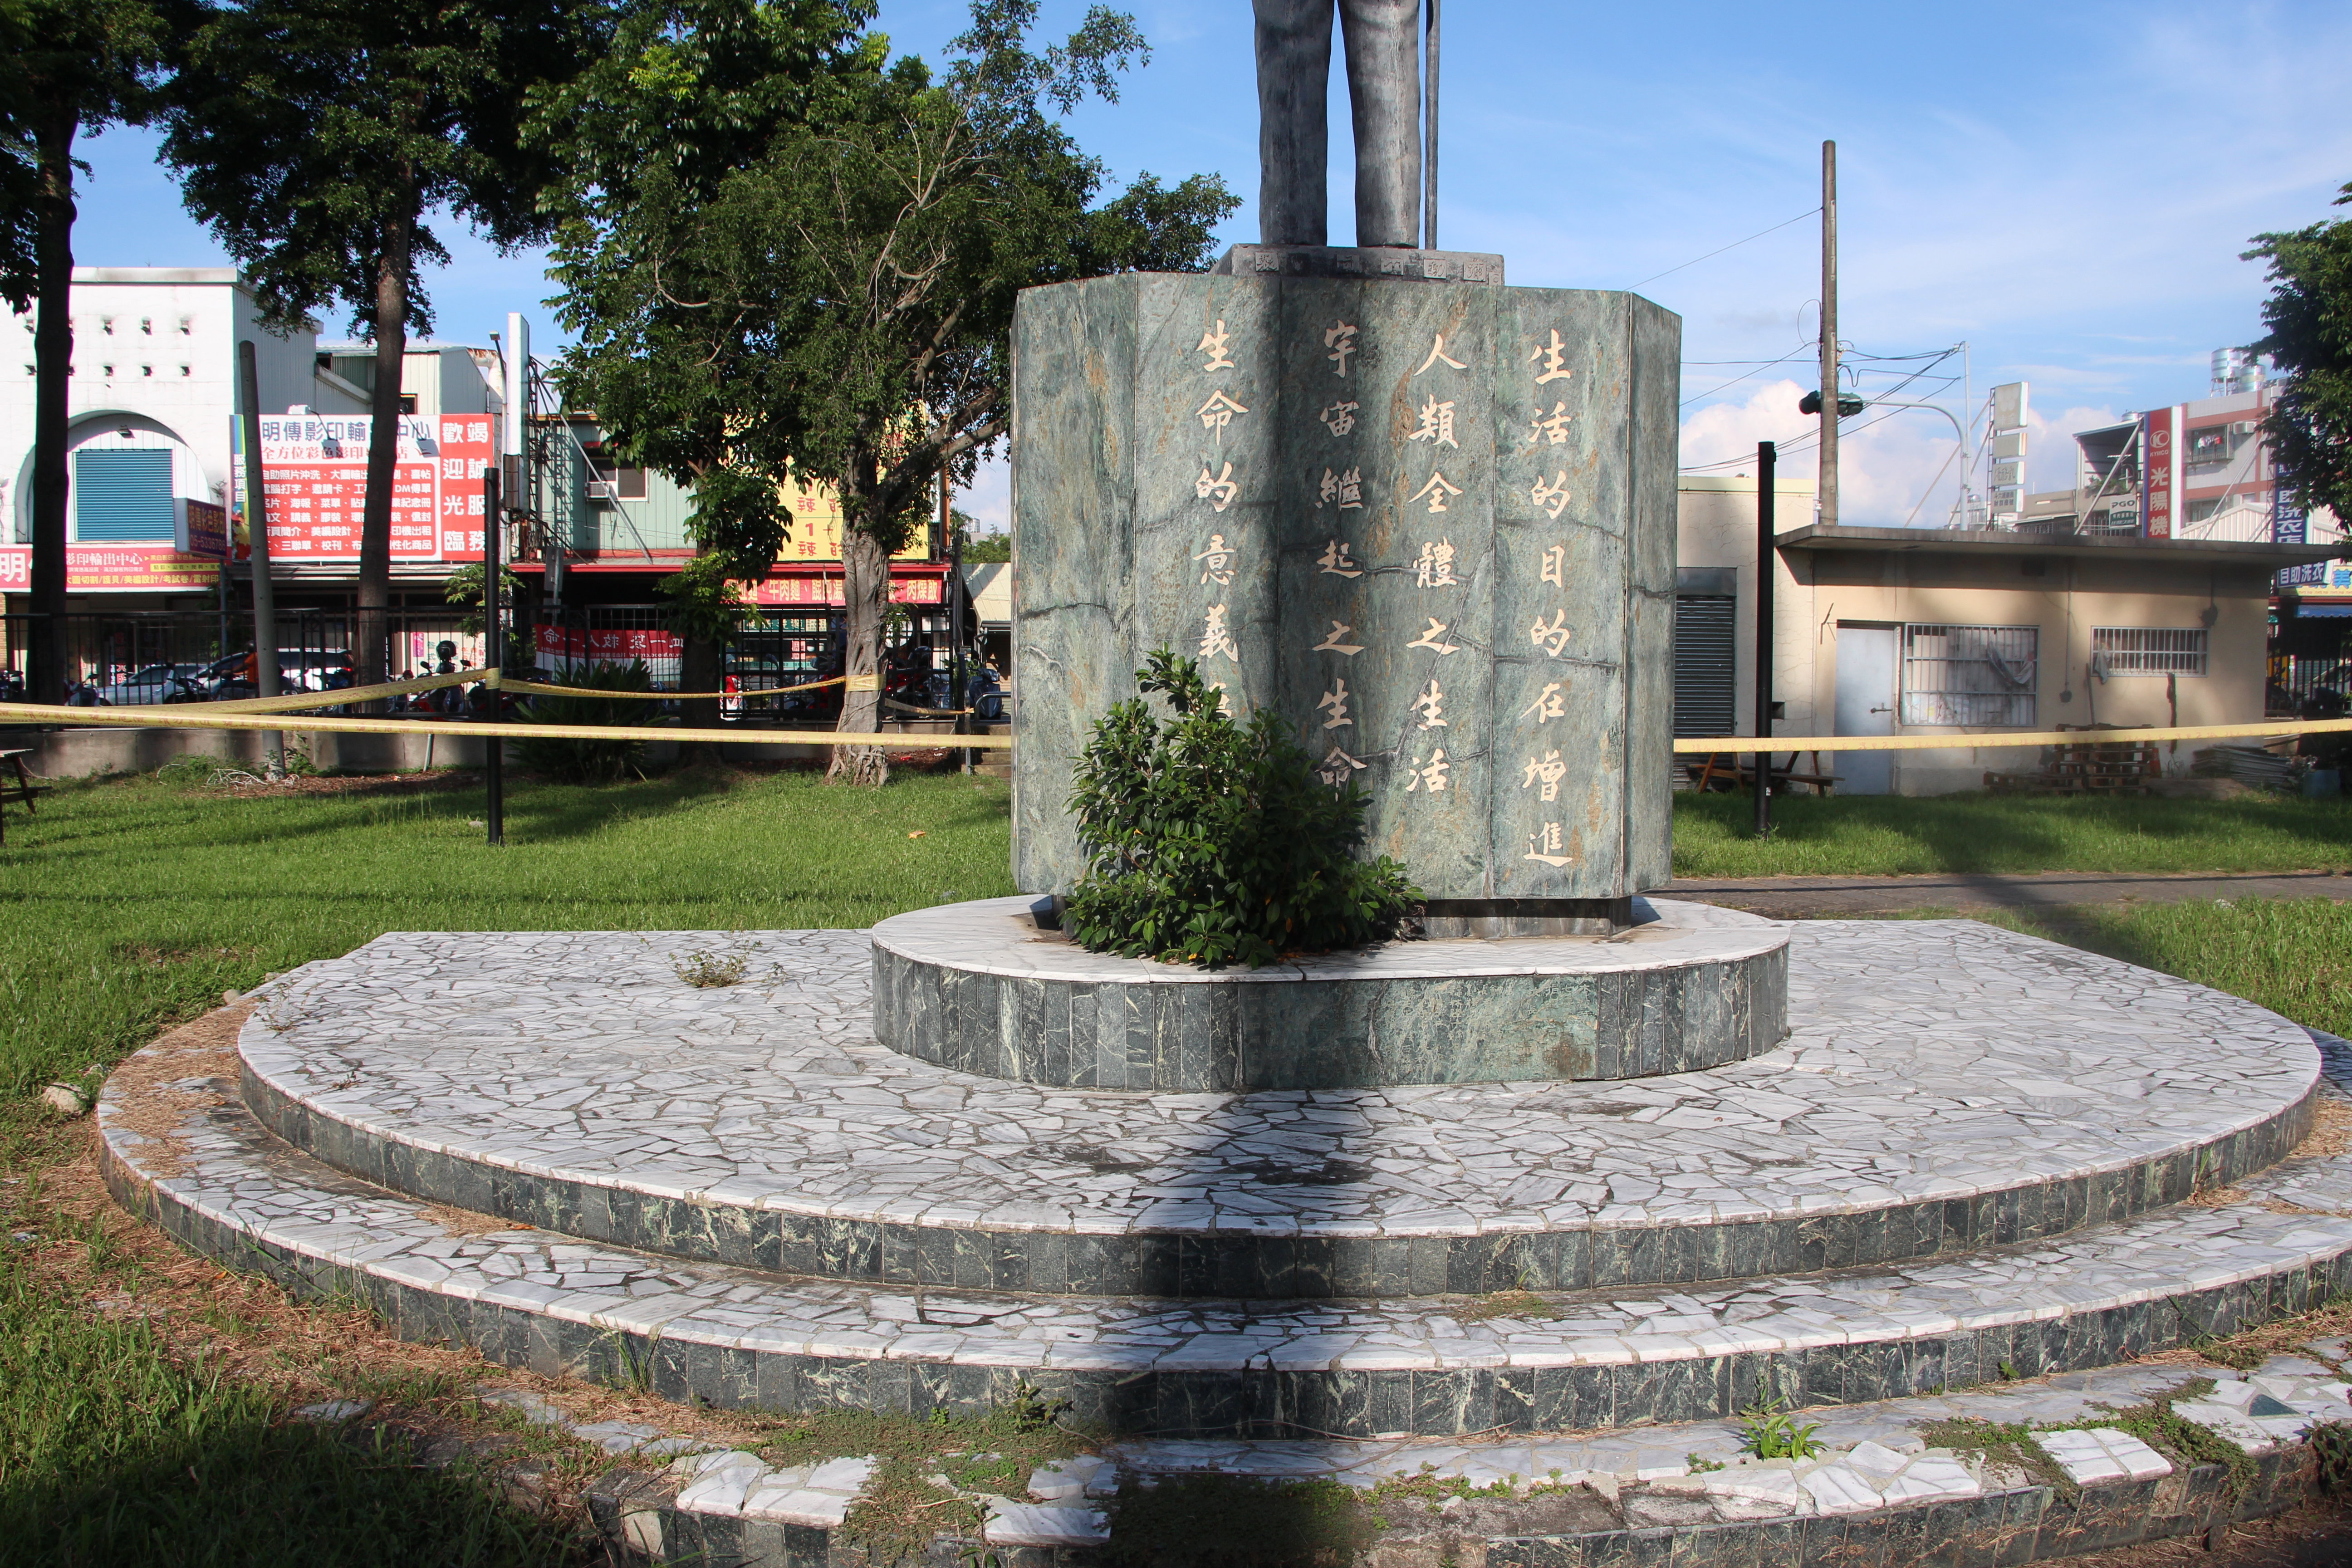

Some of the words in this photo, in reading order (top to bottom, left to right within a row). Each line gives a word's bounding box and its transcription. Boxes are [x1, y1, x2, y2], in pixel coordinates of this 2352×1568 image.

[262, 421, 431, 442] 明傳影印輸中心
[234, 454, 246, 503] 服務項目
[290, 498, 311, 508] 海報
[320, 498, 341, 508] 菜單
[442, 422, 465, 552] 歡迎光臨
[2149, 467, 2168, 536] 光陽機
[2112, 500, 2135, 509] PGO
[66, 553, 143, 566] 影印輸出中心
[1312, 319, 1367, 802] 宇宙繼起之生命
[1406, 333, 1468, 794] 人類全體之生活
[2280, 562, 2325, 585] 自助洗衣
[1523, 329, 1573, 867] 生活的目的在增進
